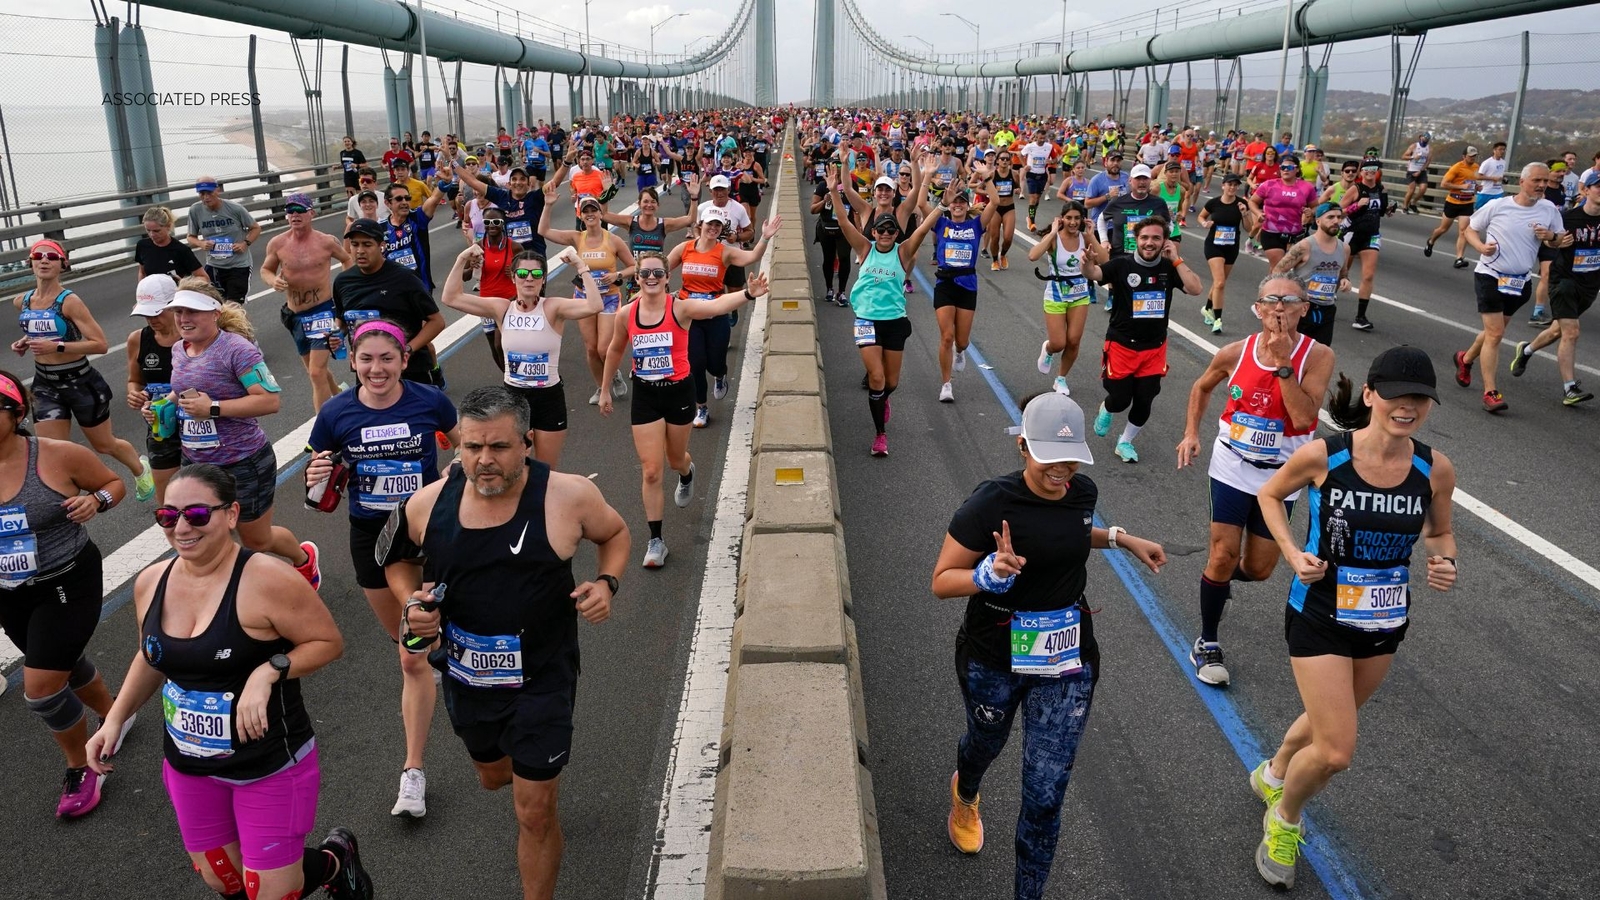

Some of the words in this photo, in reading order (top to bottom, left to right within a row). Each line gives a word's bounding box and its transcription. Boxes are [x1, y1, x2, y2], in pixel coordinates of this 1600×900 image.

[202, 220, 215, 228] JUST
[216, 219, 226, 227] DO
[865, 266, 896, 277] KARLA
[508, 314, 540, 329] RORY
[632, 333, 669, 348] BROGAN
[523, 363, 546, 376] 43390
[187, 420, 213, 435] 43298
[364, 426, 408, 440] ELISABETH
[1250, 430, 1276, 448] 48119
[367, 444, 380, 452] on
[381, 443, 395, 452] my
[400, 447, 423, 455] MATTER
[363, 463, 377, 473] tcs
[382, 475, 419, 494] 47809
[1329, 487, 1424, 515] PATRICIA
[1353, 545, 1401, 561] CANCER
[1347, 571, 1366, 583] tcs
[1371, 586, 1403, 609] 50272
[1020, 616, 1038, 628] tcs
[451, 628, 466, 644] tcs
[1044, 626, 1077, 654] 47000
[471, 651, 516, 670] 60629
[180, 710, 224, 738] 53630
[216, 858, 224, 866] KT
